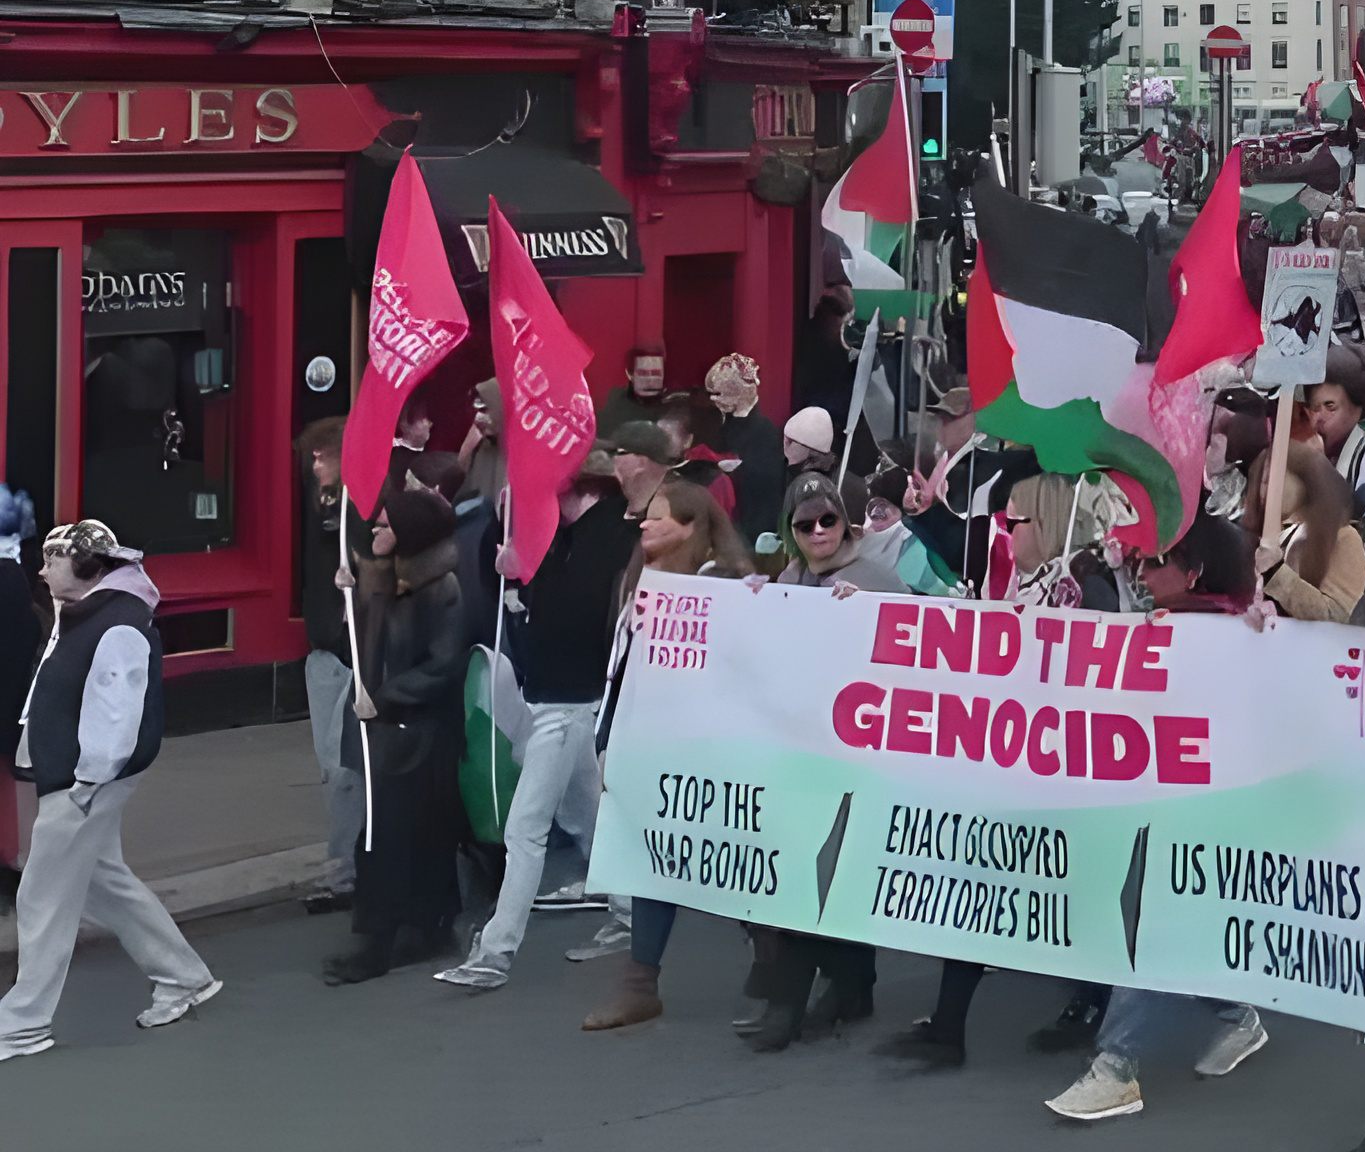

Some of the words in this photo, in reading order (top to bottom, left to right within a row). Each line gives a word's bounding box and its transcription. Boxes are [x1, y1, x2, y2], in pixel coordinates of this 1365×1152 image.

[0, 88, 299, 146] YLES
[521, 228, 609, 260] INNESS
[870, 602, 1022, 677] END
[1035, 617, 1174, 692] THE
[832, 681, 1211, 784] GENOCIDE
[657, 773, 716, 823] STOP
[723, 782, 766, 832] THE
[885, 804, 962, 862] ENACT
[644, 828, 692, 882] WAR
[700, 839, 780, 896] BONDS
[1171, 843, 1206, 895] US
[1216, 845, 1361, 921] WARPLANES
[871, 866, 1021, 938] TERRITORIES
[1026, 890, 1073, 947] BILL
[1224, 916, 1255, 972] OF
